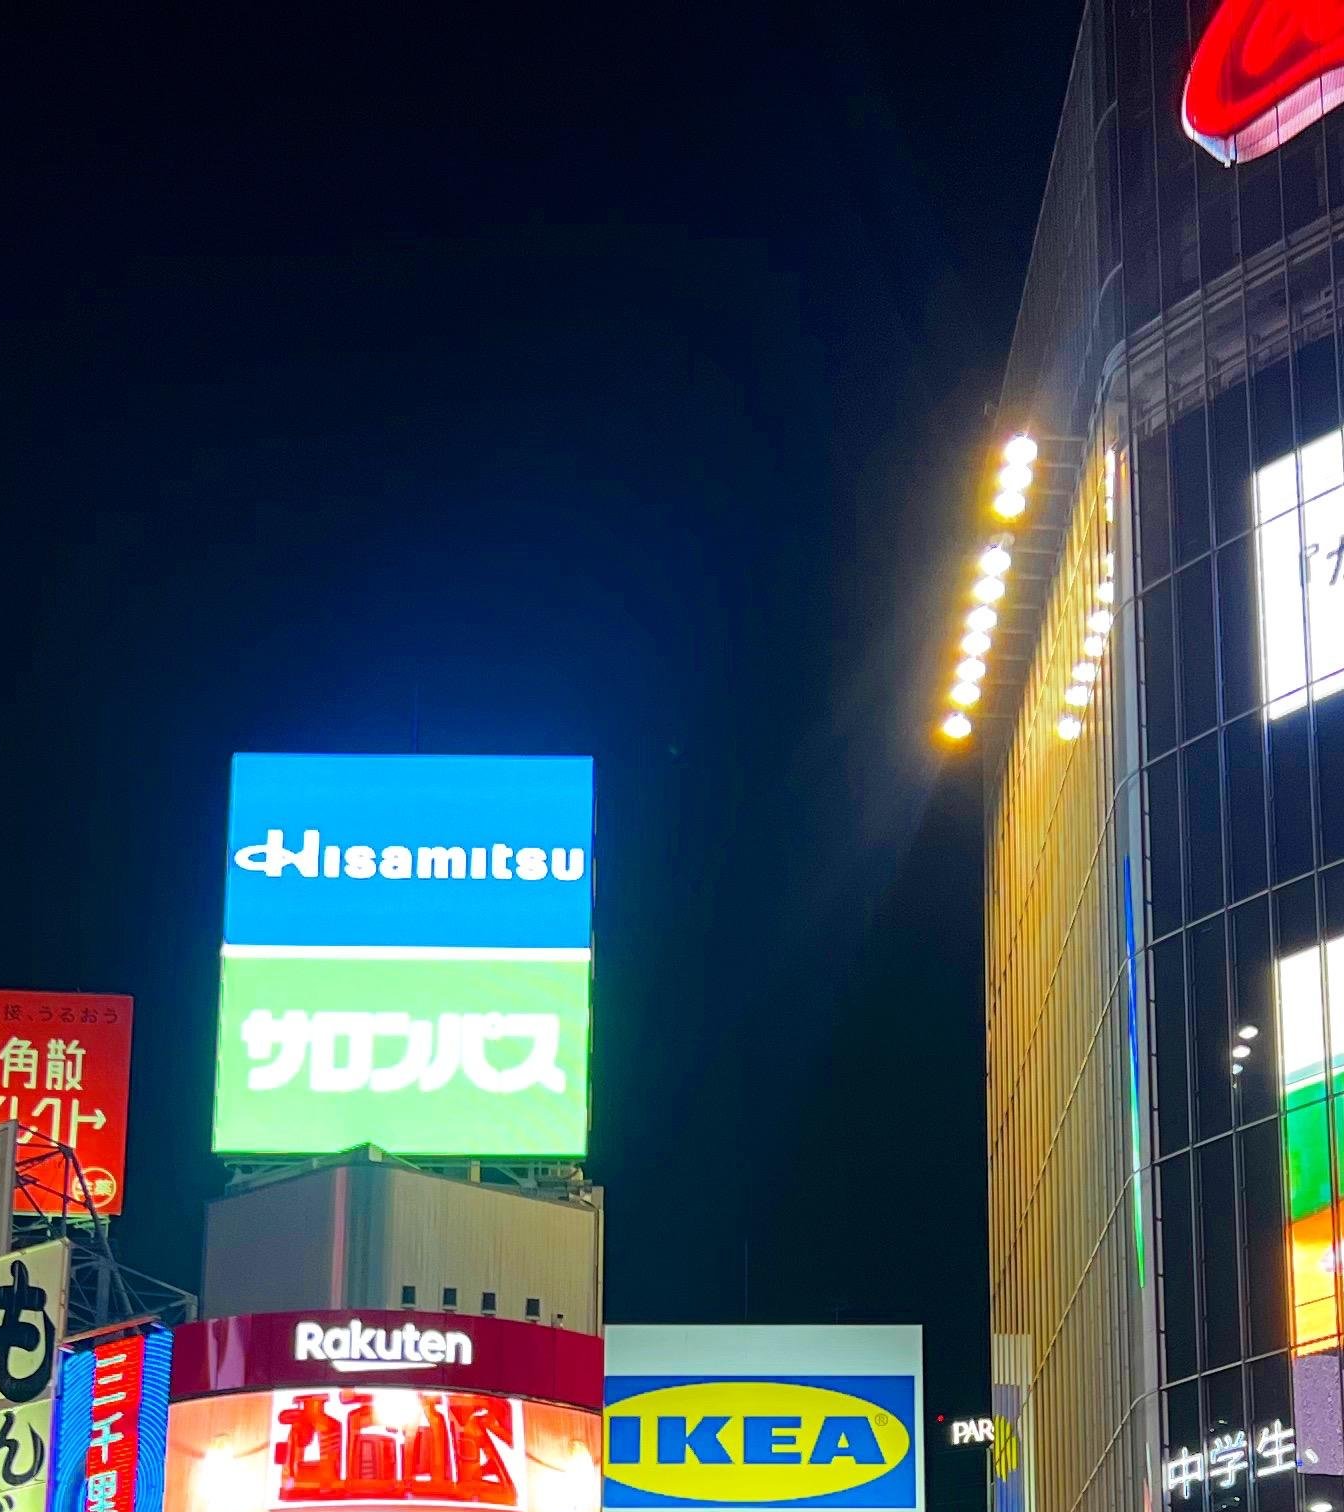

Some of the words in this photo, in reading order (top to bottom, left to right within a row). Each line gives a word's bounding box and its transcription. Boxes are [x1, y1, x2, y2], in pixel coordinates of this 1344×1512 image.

[235, 829, 585, 881] Hisamitsu
[241, 1009, 566, 1093] サロンパス
[295, 1321, 473, 1371] Rakuten
[608, 1415, 887, 1465] IKEA
[952, 1420, 994, 1445] PAR
